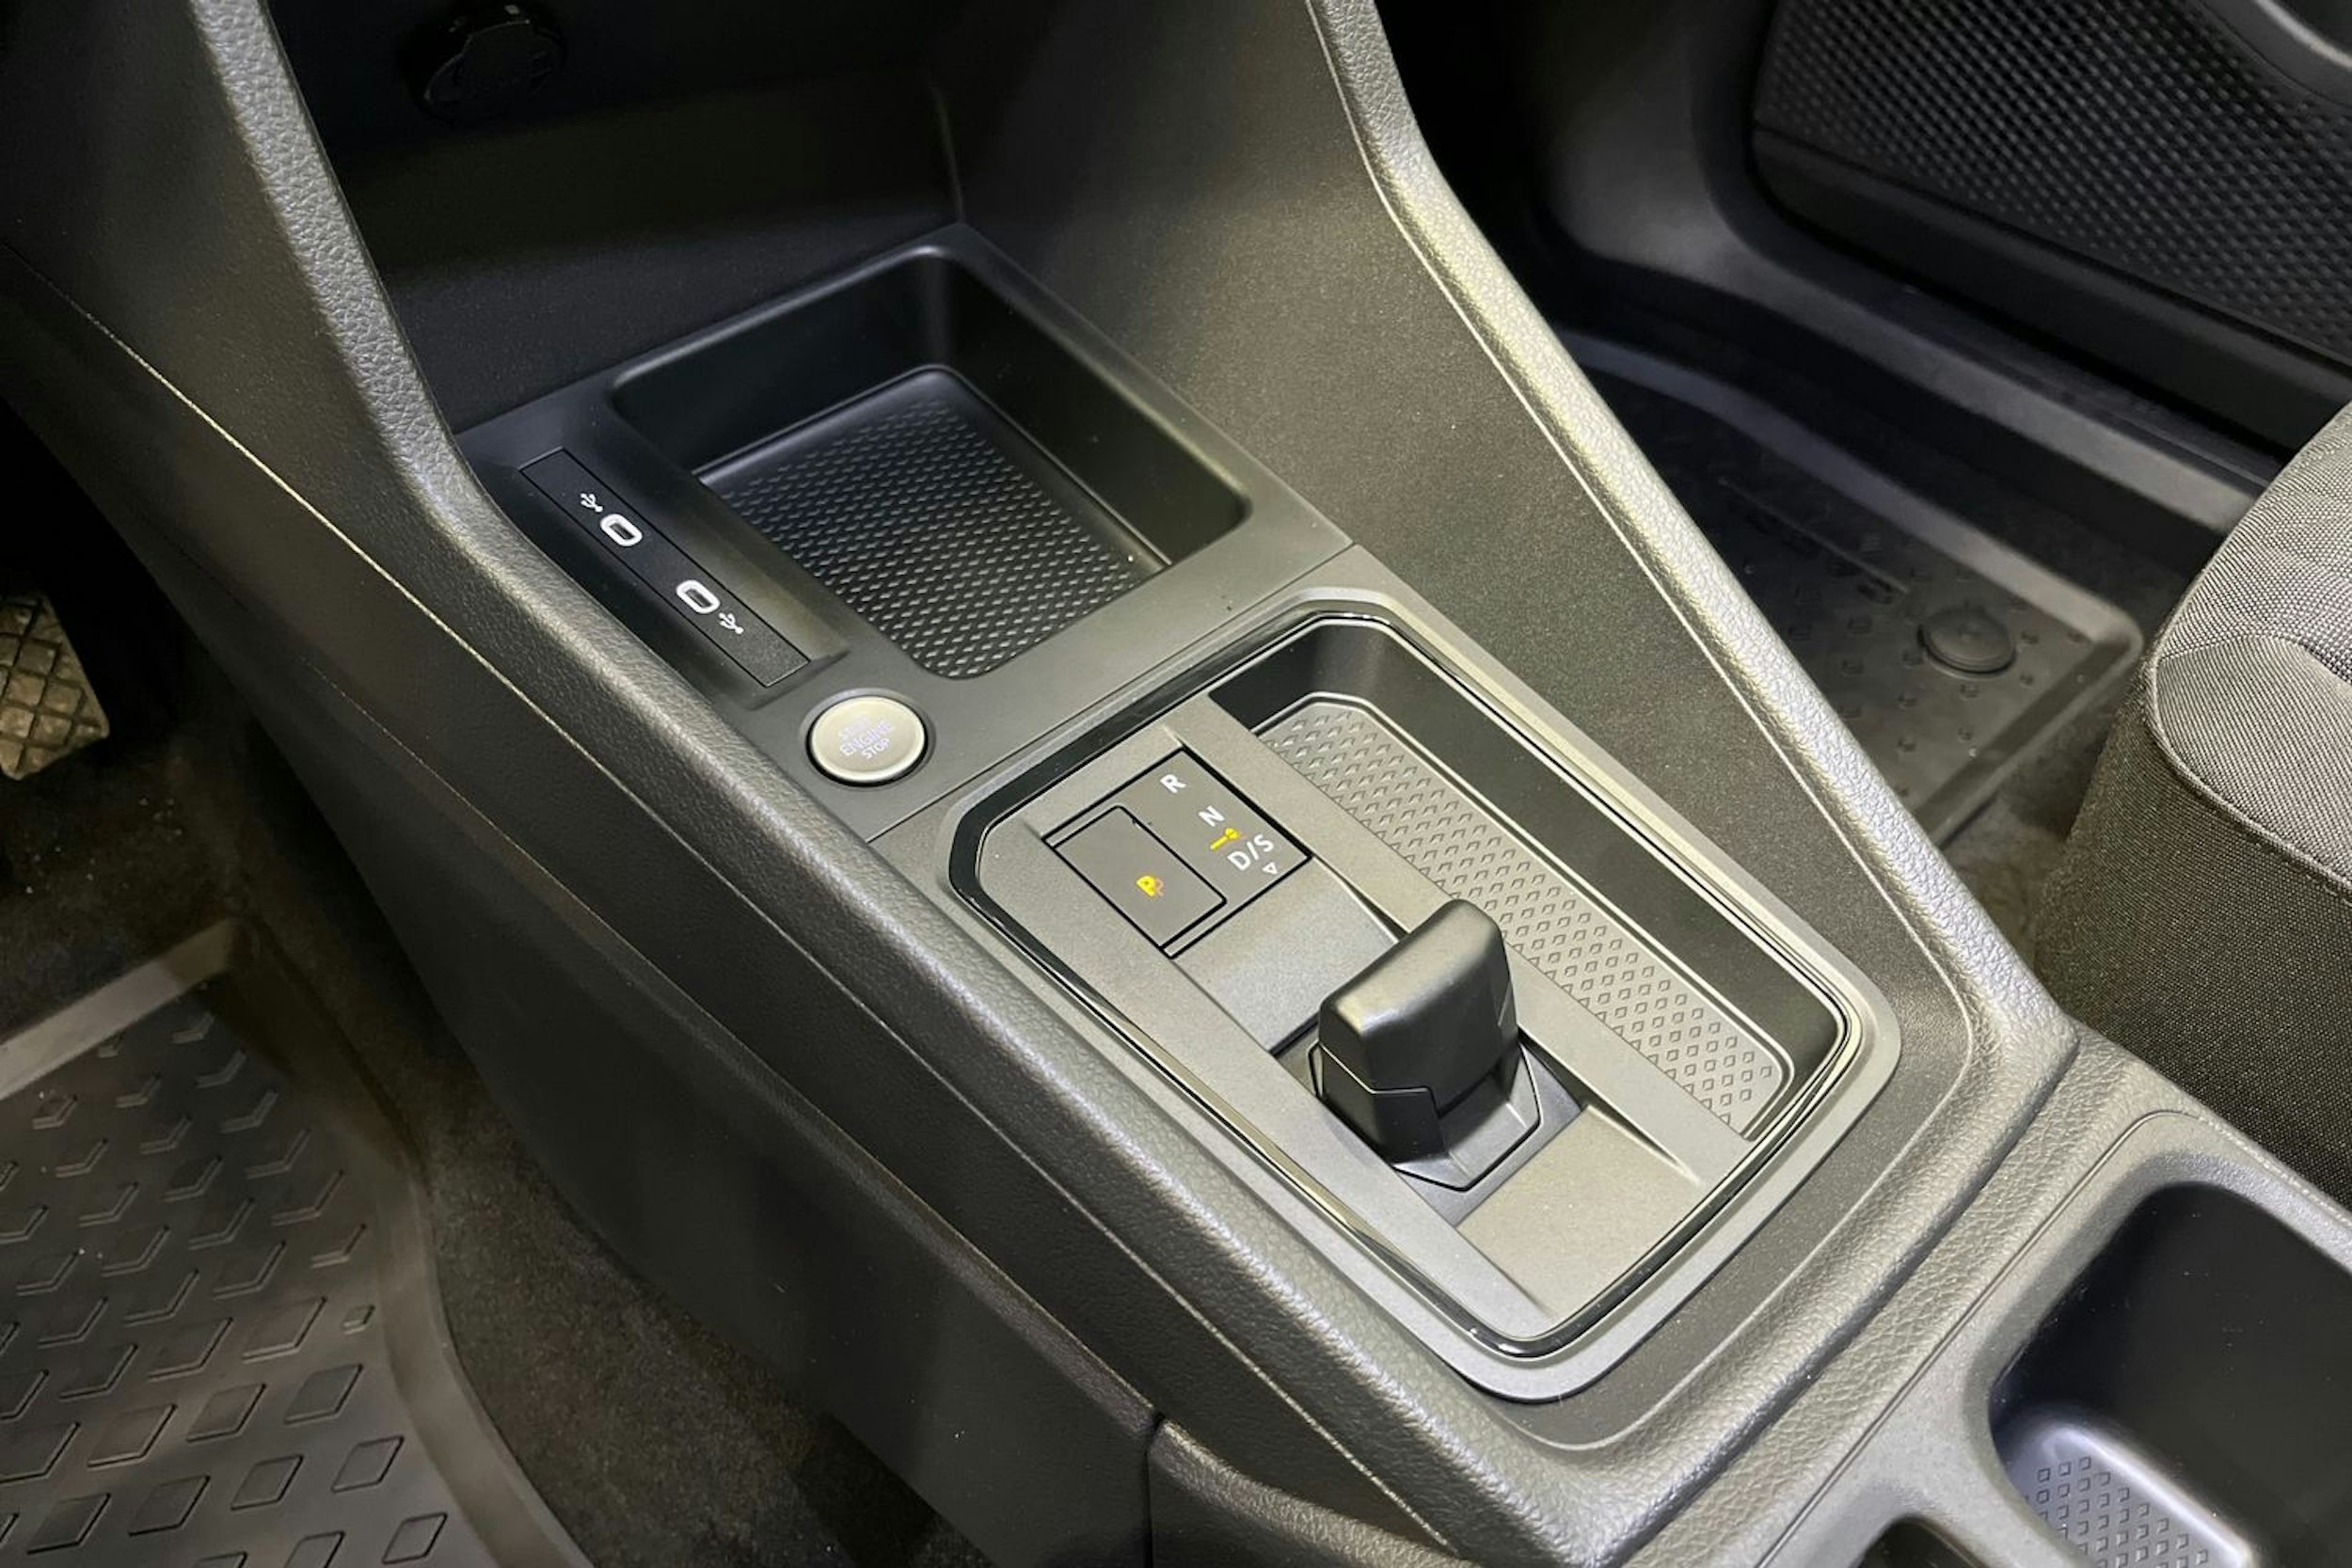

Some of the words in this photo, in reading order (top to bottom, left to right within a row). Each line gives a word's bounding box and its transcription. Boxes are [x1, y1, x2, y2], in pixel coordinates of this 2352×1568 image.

[1160, 773, 1186, 793] R
[1199, 806, 1225, 827] N
[1228, 834, 1274, 870] D/S
[1136, 876, 1160, 896] P
